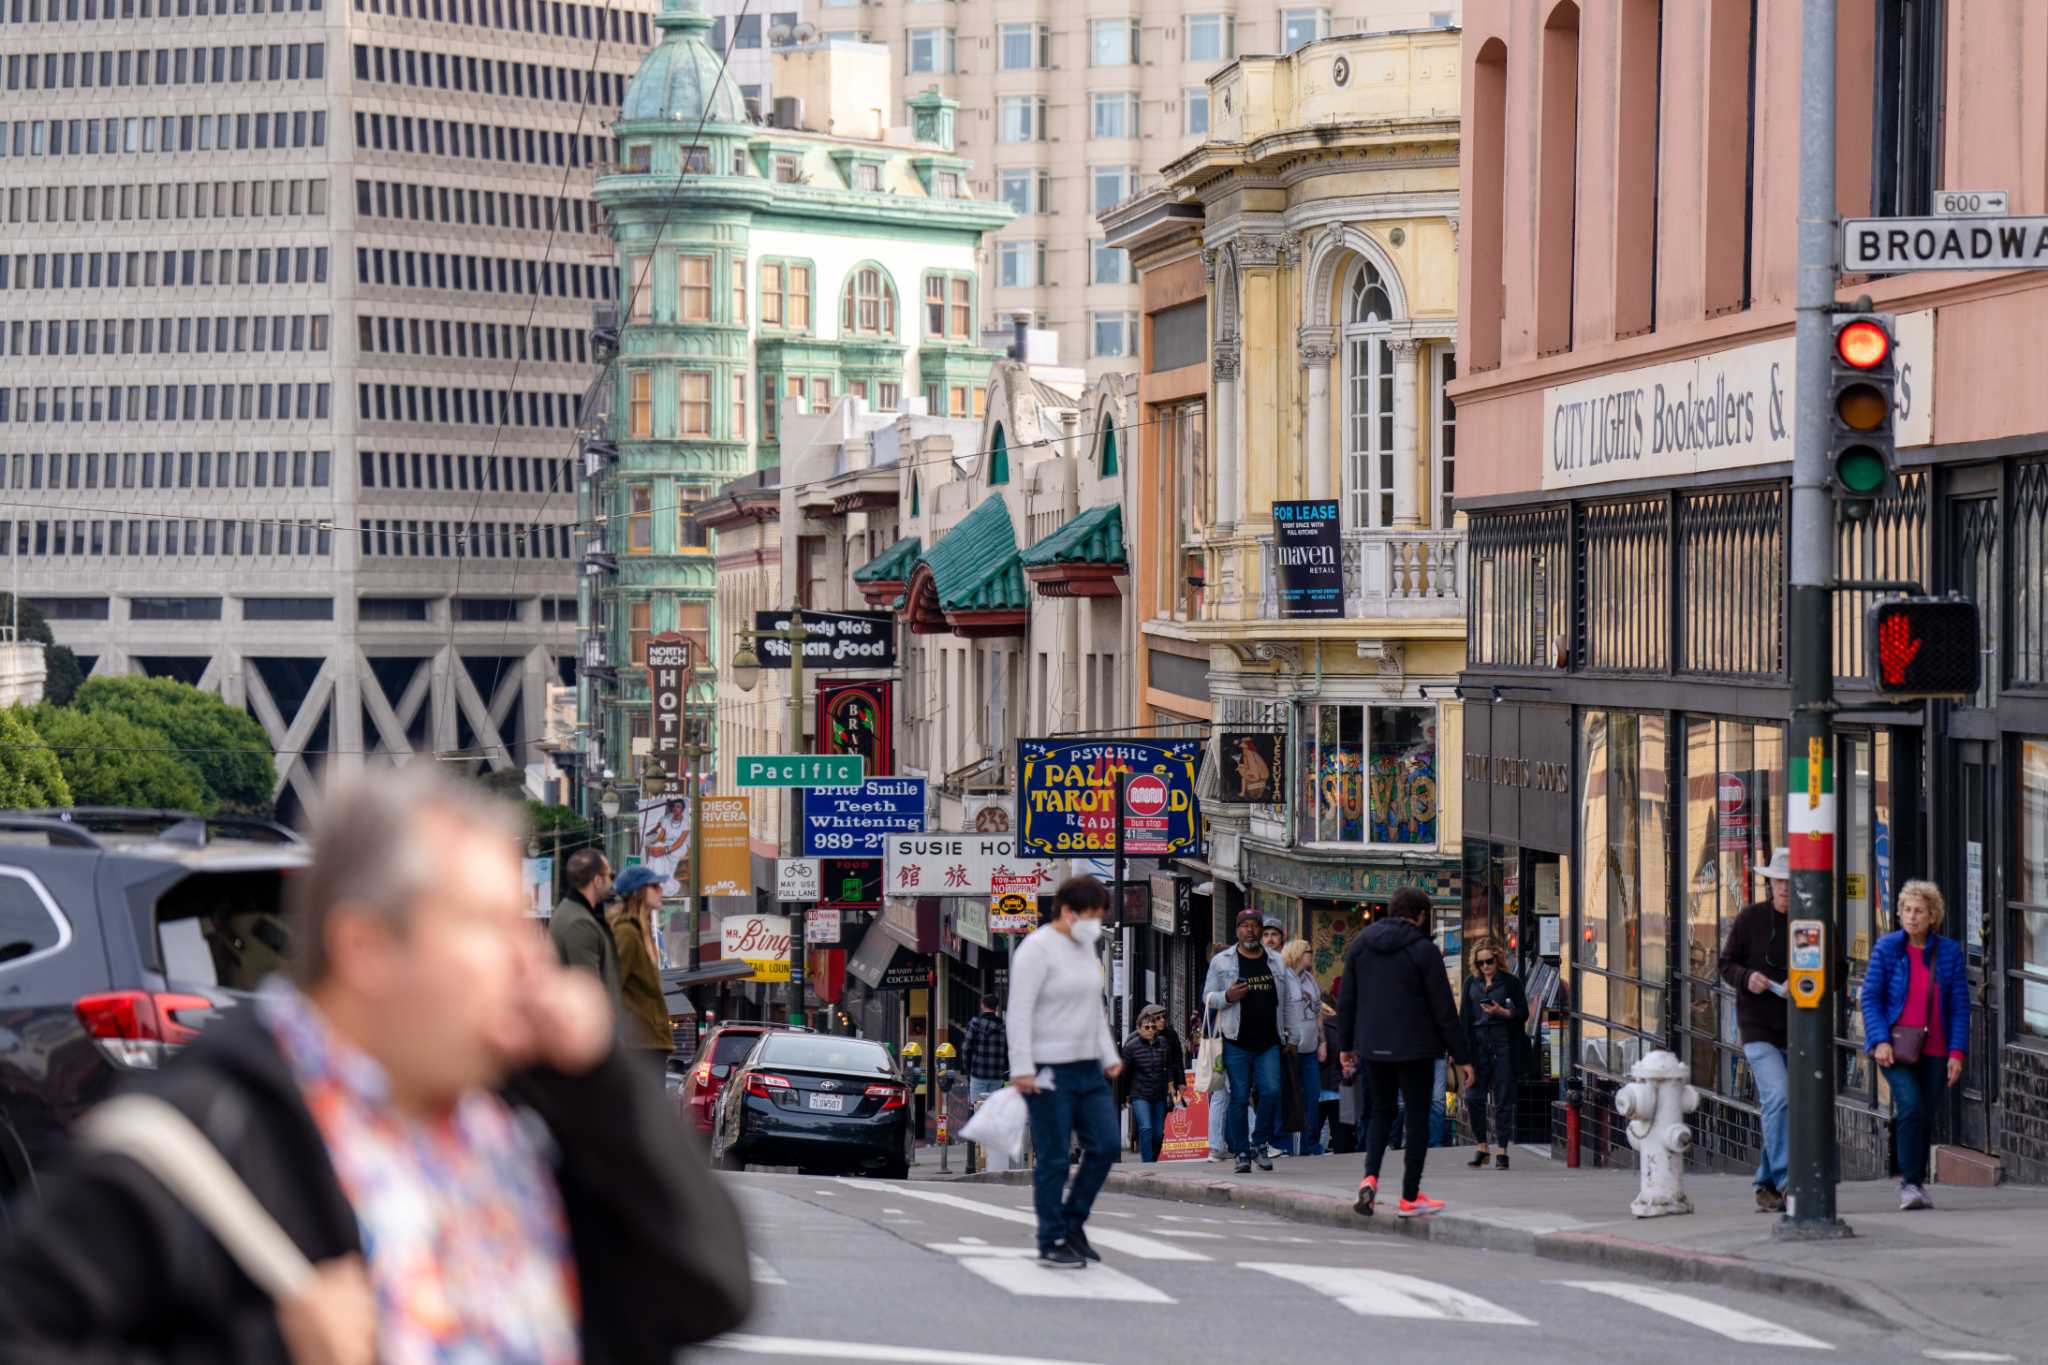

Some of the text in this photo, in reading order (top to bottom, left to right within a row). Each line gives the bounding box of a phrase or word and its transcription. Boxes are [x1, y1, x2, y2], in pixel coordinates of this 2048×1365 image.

[1944, 195, 1980, 212] 600
[1553, 362, 1787, 471] CITY LIGHTS Booksellers &
[1273, 505, 1337, 520] FOR LEASE
[1278, 544, 1336, 566] maven
[774, 621, 872, 637] Bndy Ho's
[649, 647, 687, 656] NORTH
[764, 640, 885, 660] Huan Food
[649, 656, 687, 665] BEACH
[1071, 747, 1148, 762] PSYCHIC
[750, 763, 849, 779] Pacific
[1272, 735, 1282, 801] VESUVIO
[664, 783, 679, 792] 35
[866, 782, 918, 796] Smile
[703, 801, 743, 811] DIEGO
[834, 800, 897, 812] Teeth
[1032, 789, 1116, 812] TAROT
[703, 812, 747, 822] RIVERA
[809, 815, 921, 832] Whitening
[1066, 813, 1116, 829] READI
[814, 833, 885, 849] 989-27
[899, 841, 1015, 855] SUSIE HO
[1056, 832, 1116, 850] 986.9
[992, 884, 1005, 894] NO
[725, 928, 742, 939] MR.
[728, 918, 792, 960] Bing
[769, 963, 790, 975] LOUN
[886, 974, 929, 984] COCKTAIL
